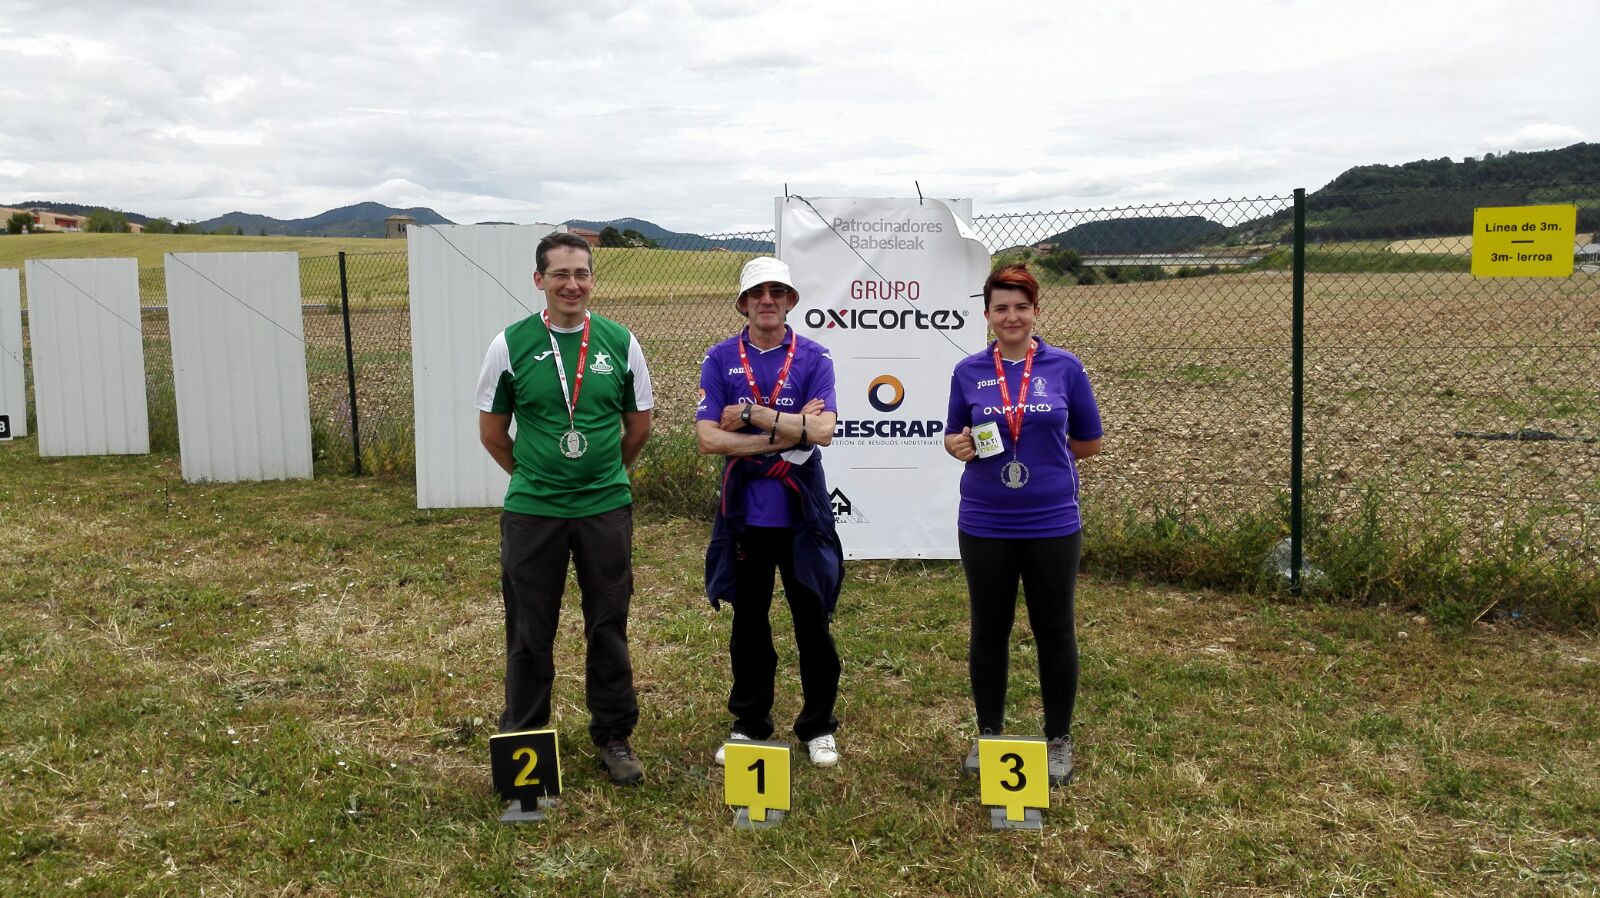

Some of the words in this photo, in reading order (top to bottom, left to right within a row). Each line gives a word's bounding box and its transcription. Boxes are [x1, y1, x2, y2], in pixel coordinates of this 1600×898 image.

[833, 217, 943, 233] Patrocinadores
[1485, 222, 1518, 233] Línea
[1521, 221, 1536, 232] de
[1540, 221, 1562, 232] 3m.
[849, 235, 925, 250] Babesleak
[1491, 253, 1513, 262] 3m-
[850, 280, 920, 301] GRUPO
[832, 420, 944, 438] GESCRAP
[512, 747, 540, 787] 2
[747, 758, 765, 794] 1
[999, 752, 1027, 792] 3
